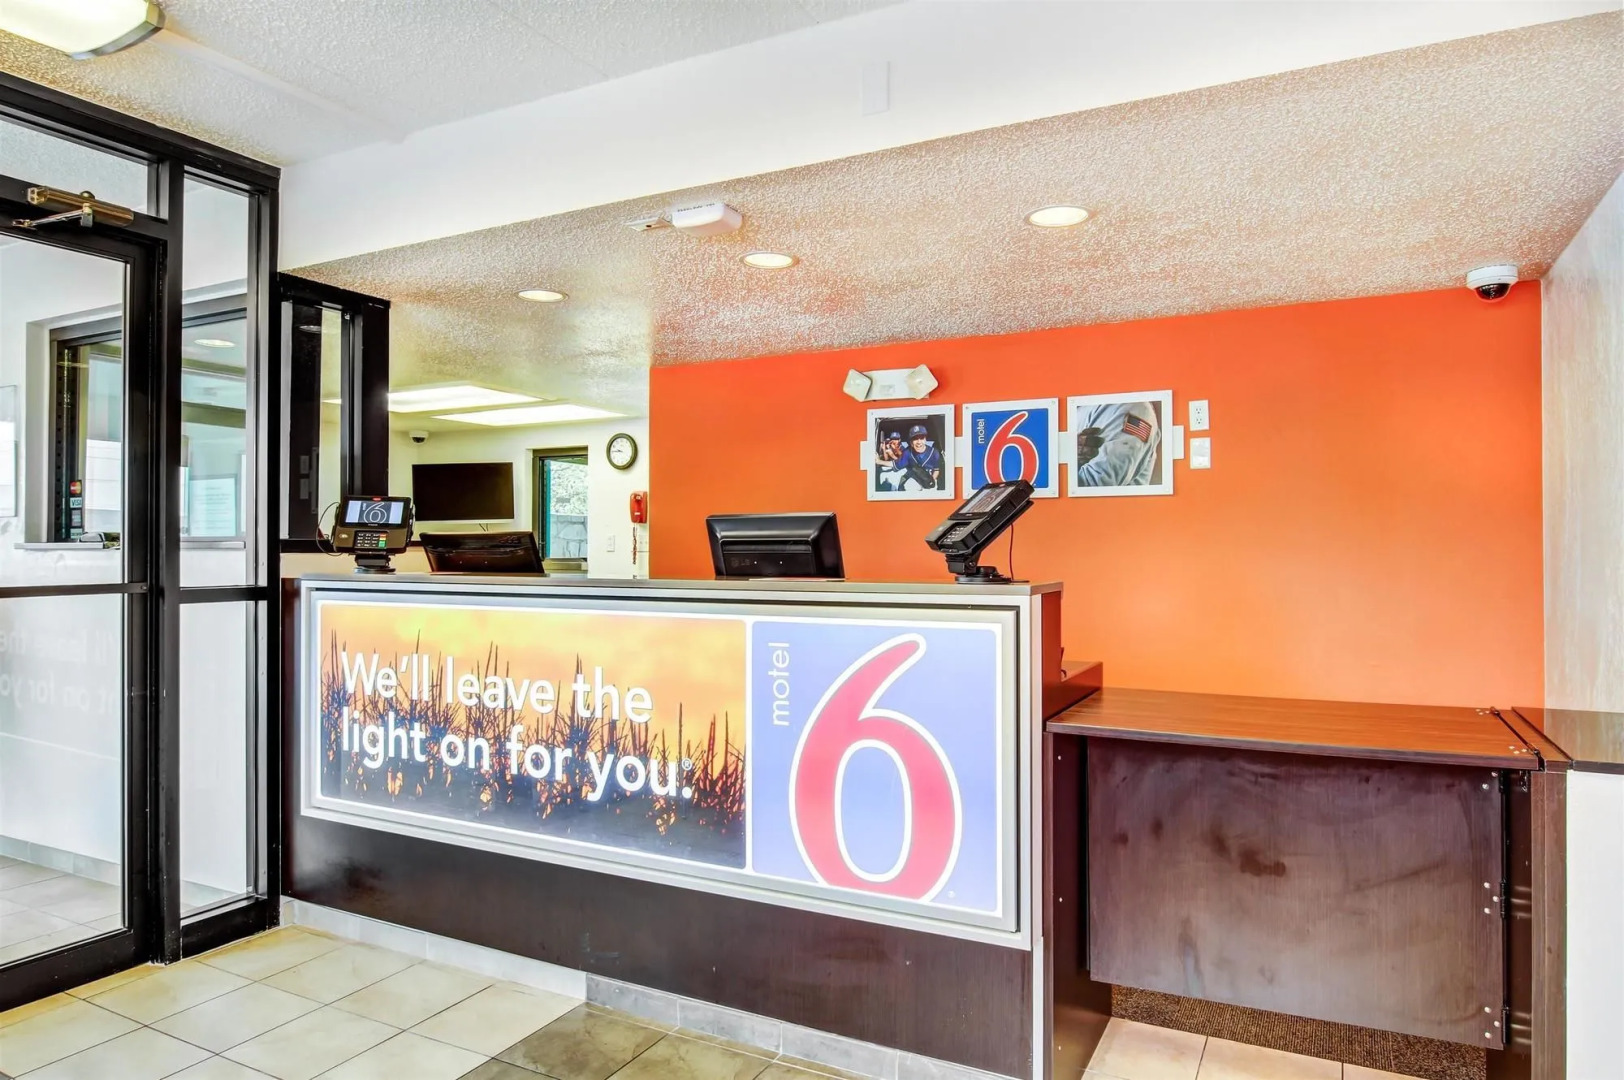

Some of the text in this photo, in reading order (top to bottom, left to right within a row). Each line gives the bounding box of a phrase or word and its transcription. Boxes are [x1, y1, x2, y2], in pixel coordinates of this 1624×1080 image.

[976, 410, 1039, 484] motel 6
[341, 651, 653, 723] We'll leave the
[342, 706, 427, 769] light
[440, 734, 490, 771] on
[506, 723, 572, 781] for
[768, 633, 962, 902] motel 6
